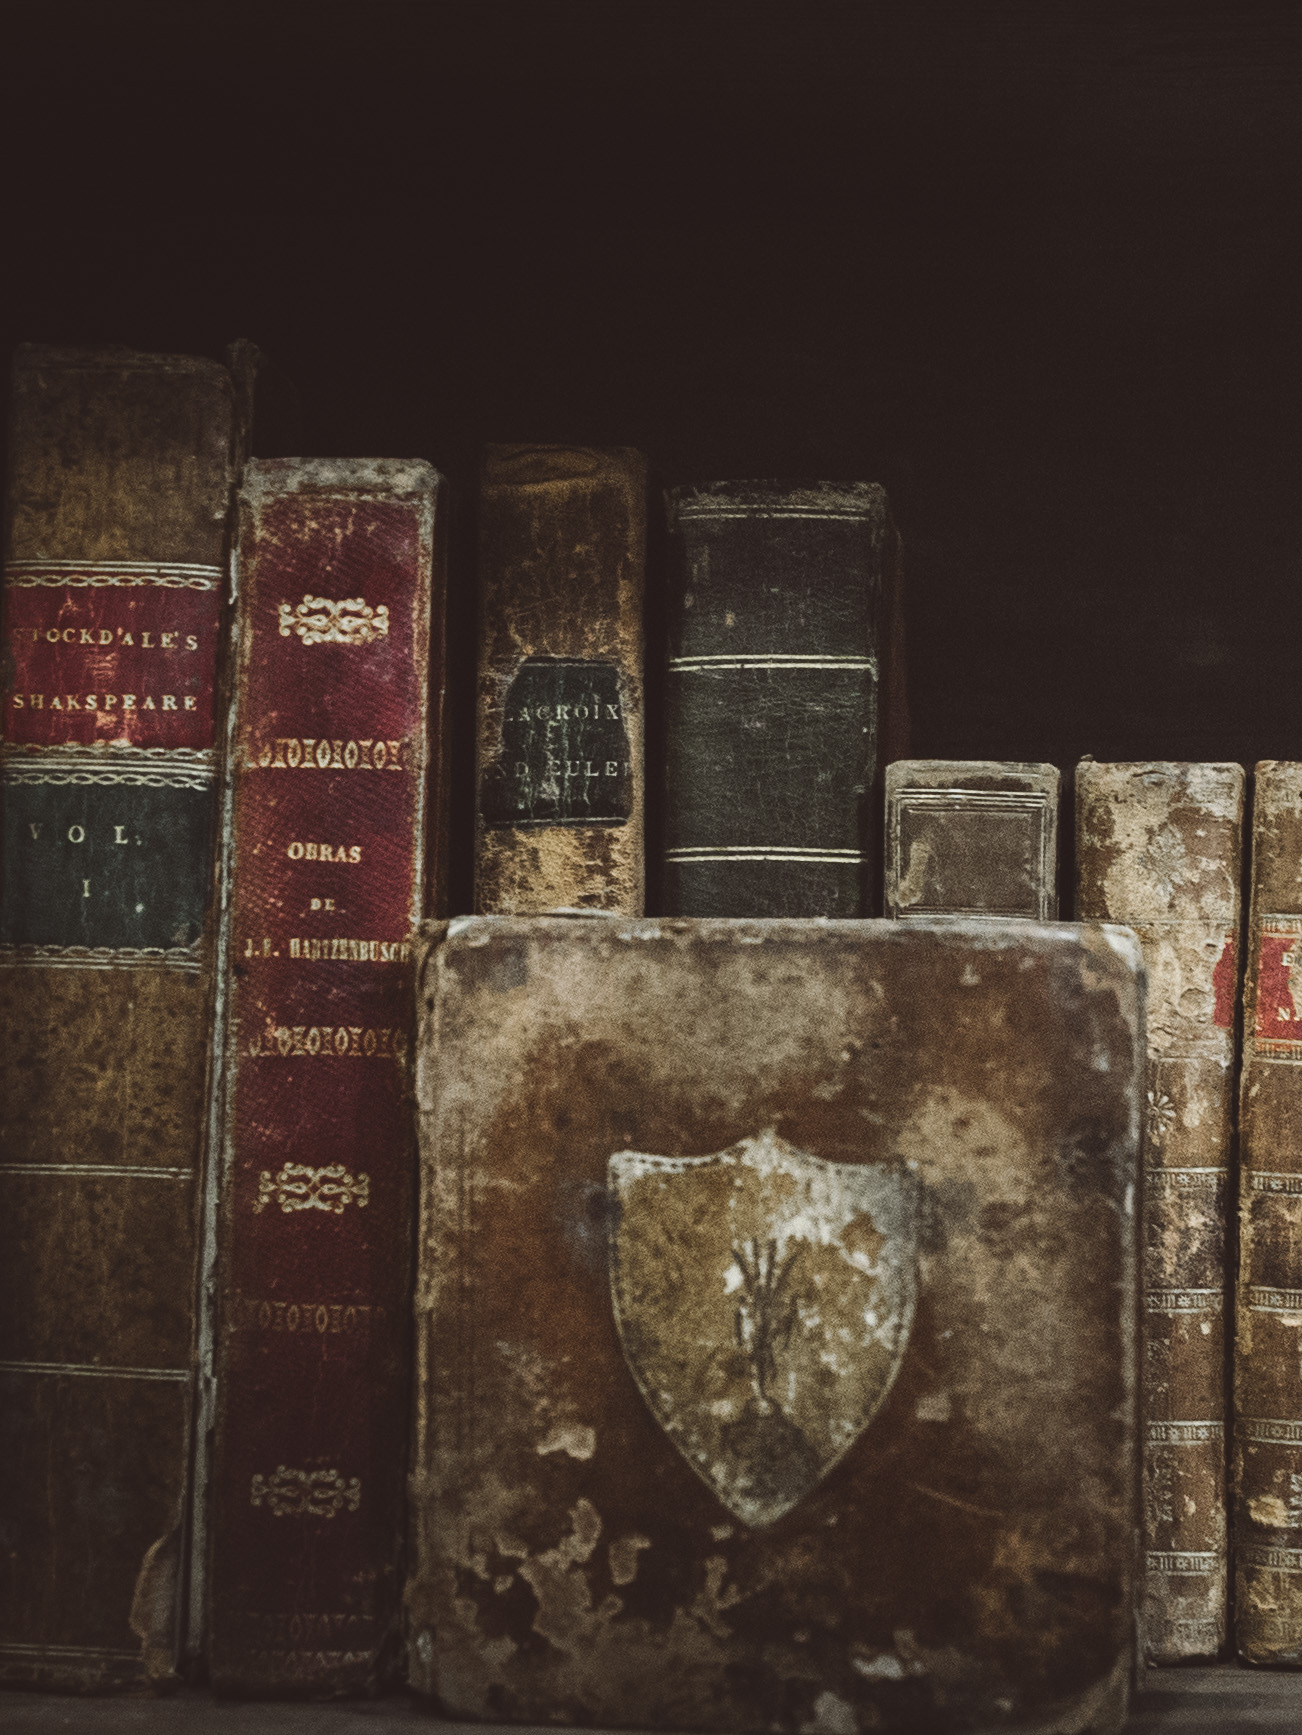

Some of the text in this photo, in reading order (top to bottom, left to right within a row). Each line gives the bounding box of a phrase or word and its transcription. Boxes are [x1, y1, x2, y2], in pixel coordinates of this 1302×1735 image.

[12, 693, 197, 711] SHAKSPEARE
[287, 841, 361, 864] OBRAS
[310, 897, 335, 911] DE
